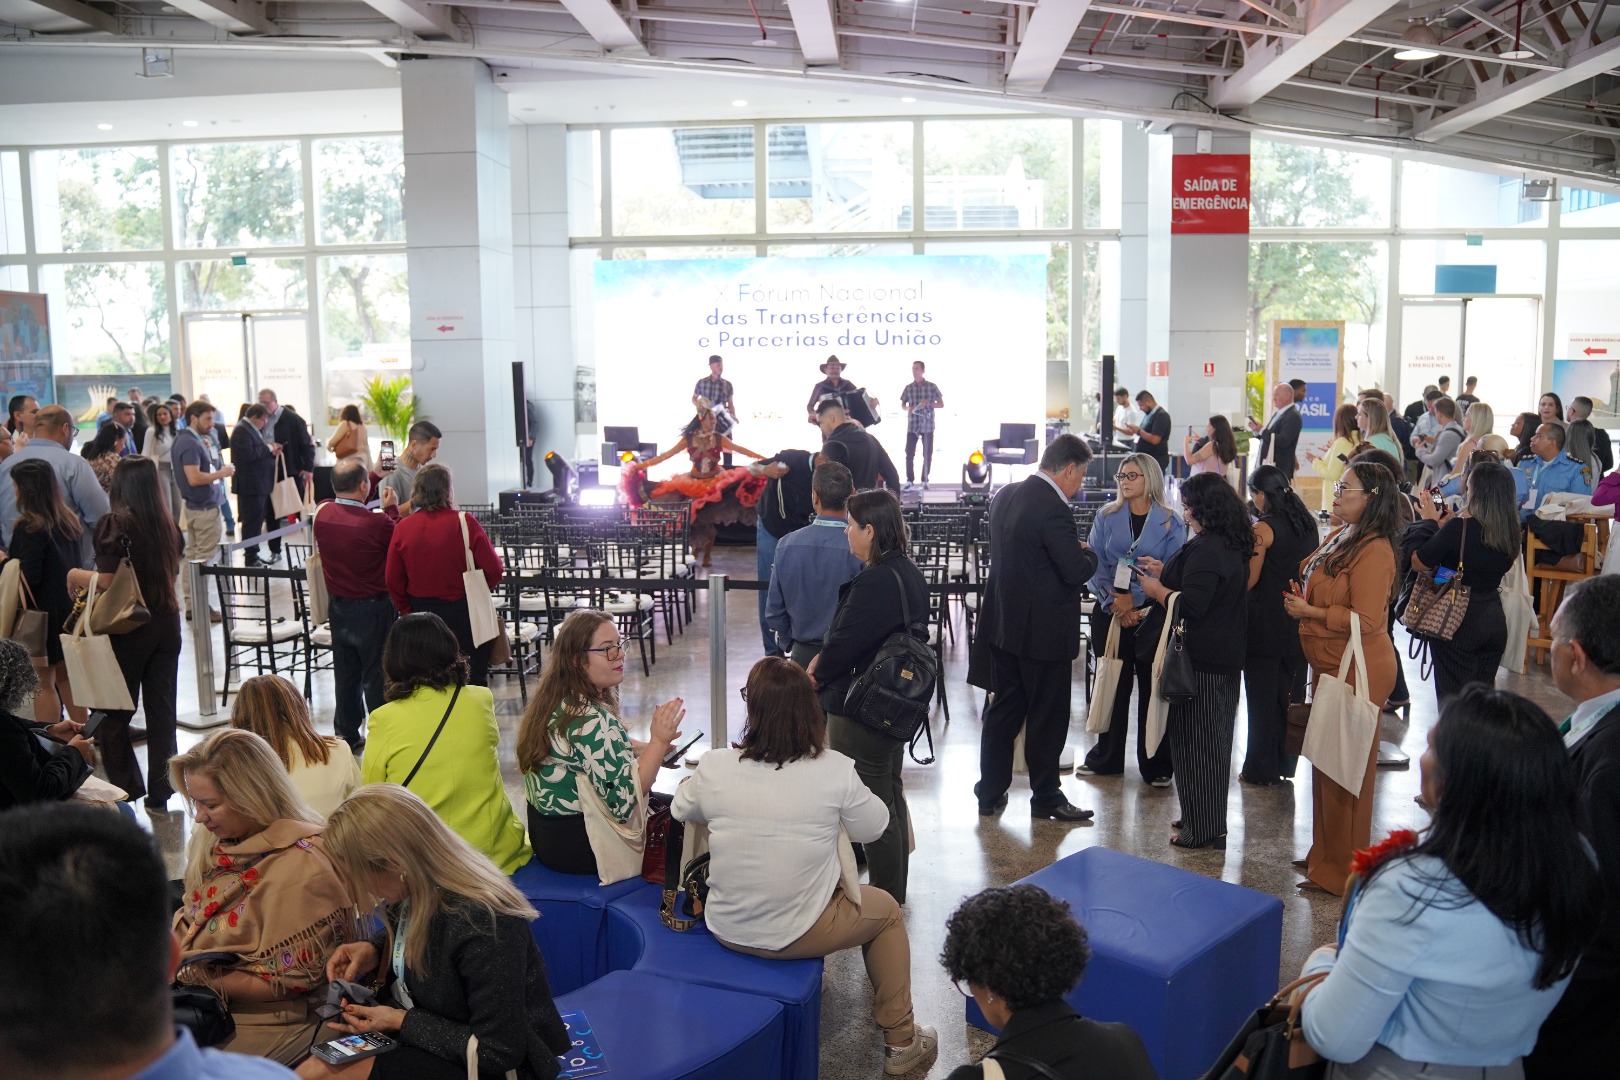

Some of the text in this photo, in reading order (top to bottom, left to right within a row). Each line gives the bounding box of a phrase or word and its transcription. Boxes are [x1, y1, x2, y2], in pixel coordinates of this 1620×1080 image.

[1183, 175, 1238, 191] SAÍDA DE
[1172, 194, 1248, 210] EMERGÊNCIA
[738, 283, 811, 303] Fórum
[820, 279, 924, 301] Nacional
[706, 305, 934, 326] das Transferências
[698, 328, 942, 348] e Parcerias da União
